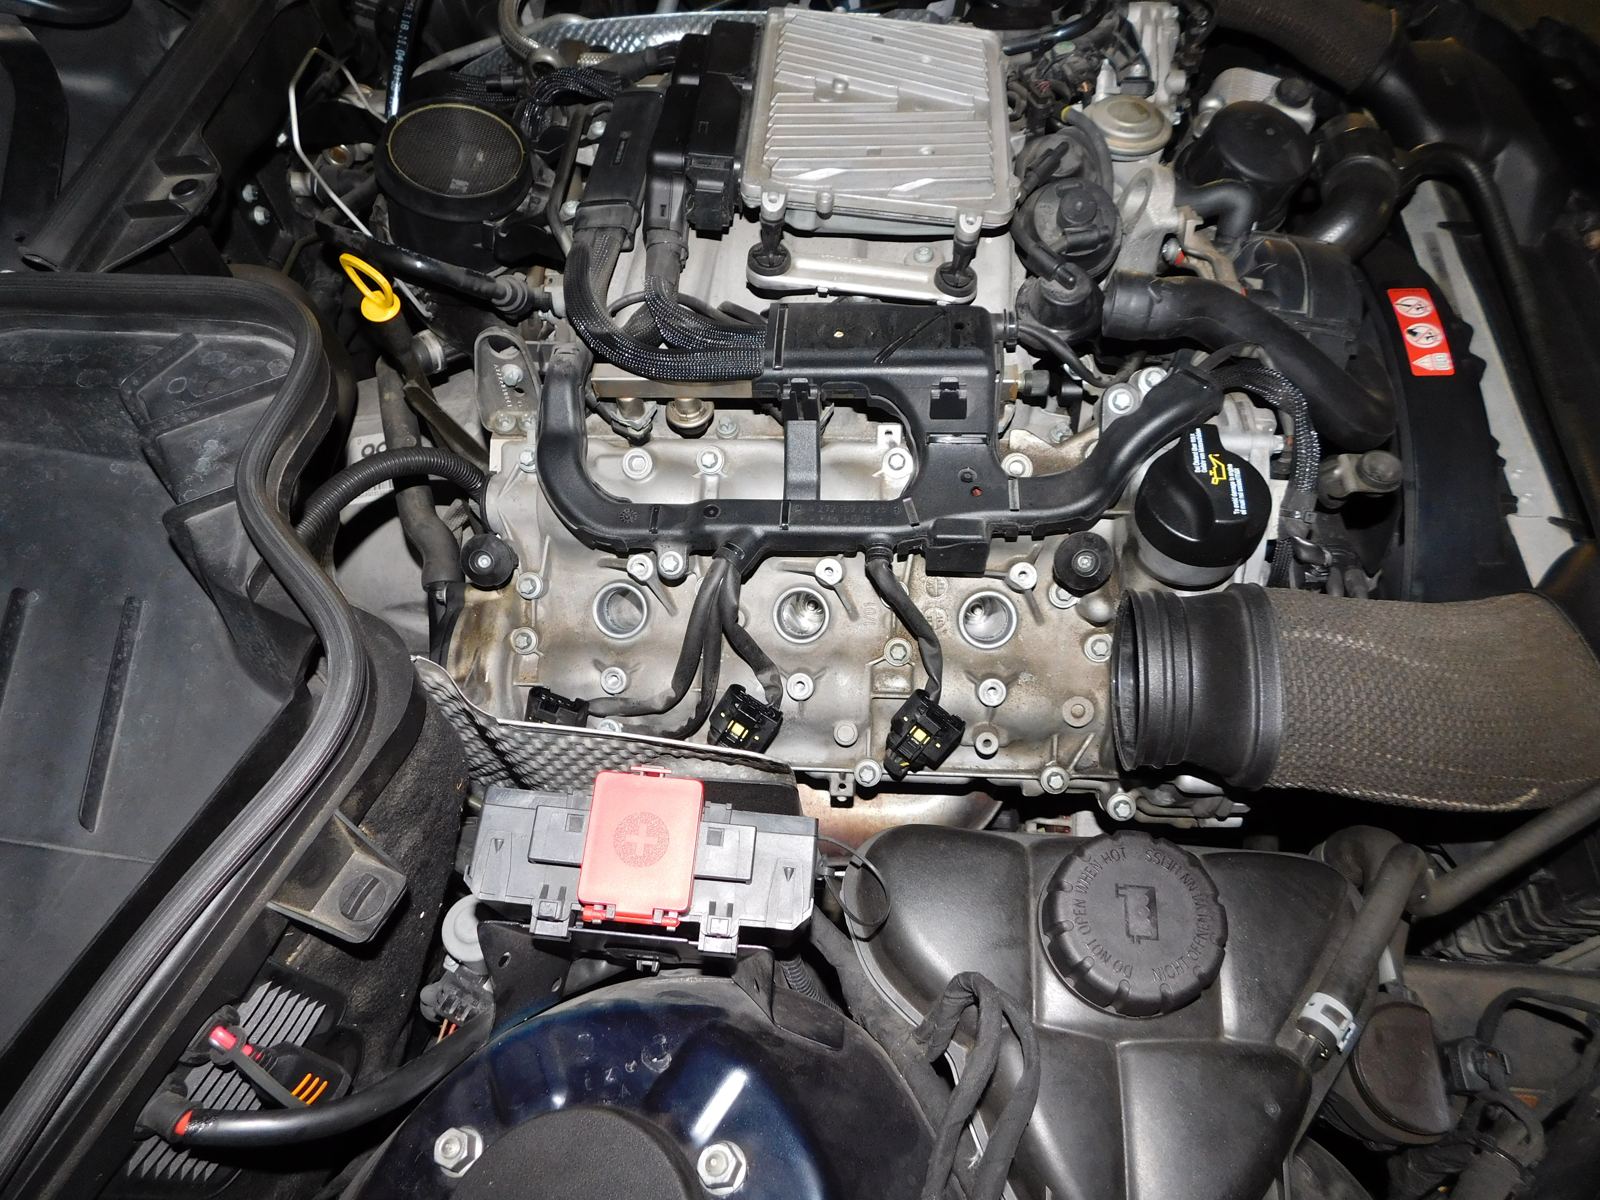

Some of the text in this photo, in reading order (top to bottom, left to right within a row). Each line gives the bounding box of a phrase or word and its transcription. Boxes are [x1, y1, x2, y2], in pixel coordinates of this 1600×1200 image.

[1144, 849, 1183, 874] HEISS
[1073, 847, 1134, 978] DO NOT OPEN WHEN HOT
[1152, 957, 1188, 982] NICHT
